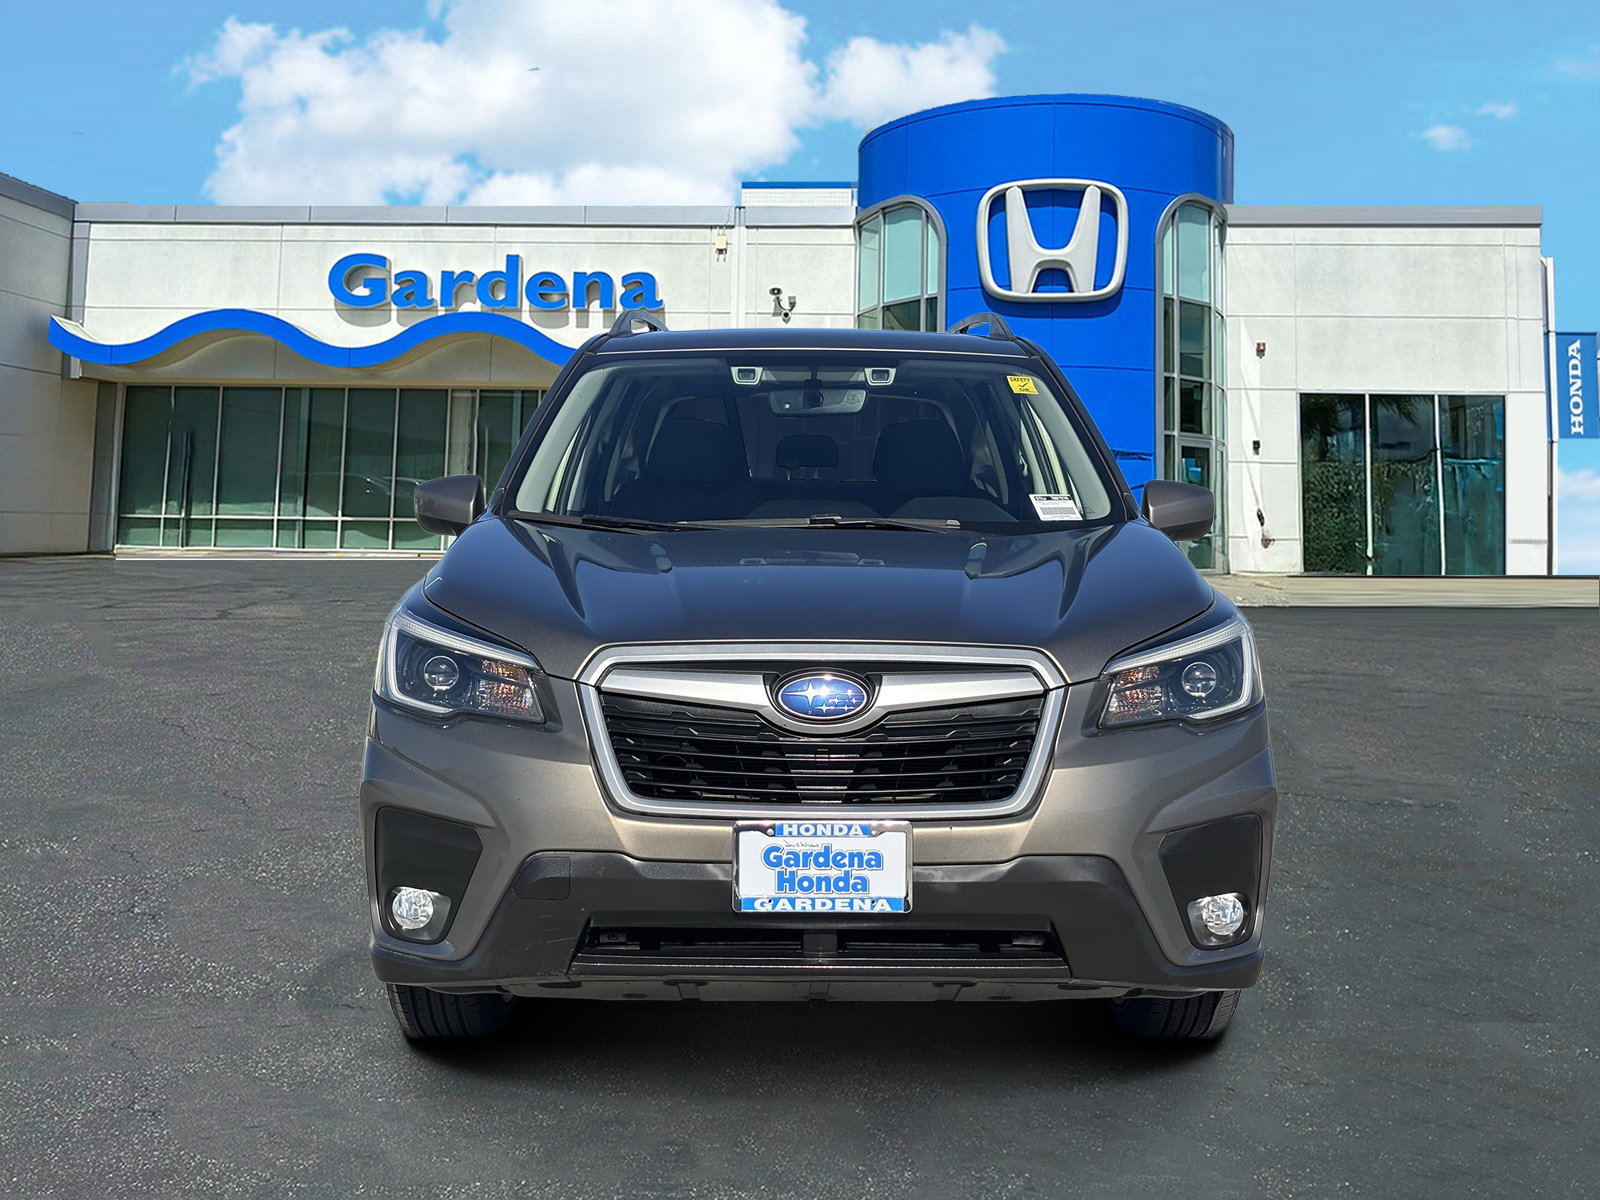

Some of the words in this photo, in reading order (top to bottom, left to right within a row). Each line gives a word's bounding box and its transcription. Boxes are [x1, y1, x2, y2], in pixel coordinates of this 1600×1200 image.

[328, 252, 663, 310] Gardena
[1568, 339, 1584, 435] HONDA
[782, 824, 863, 836] HONDA
[761, 844, 883, 869] Gardena
[776, 870, 868, 893] Honda
[753, 898, 893, 911] GARDENA
